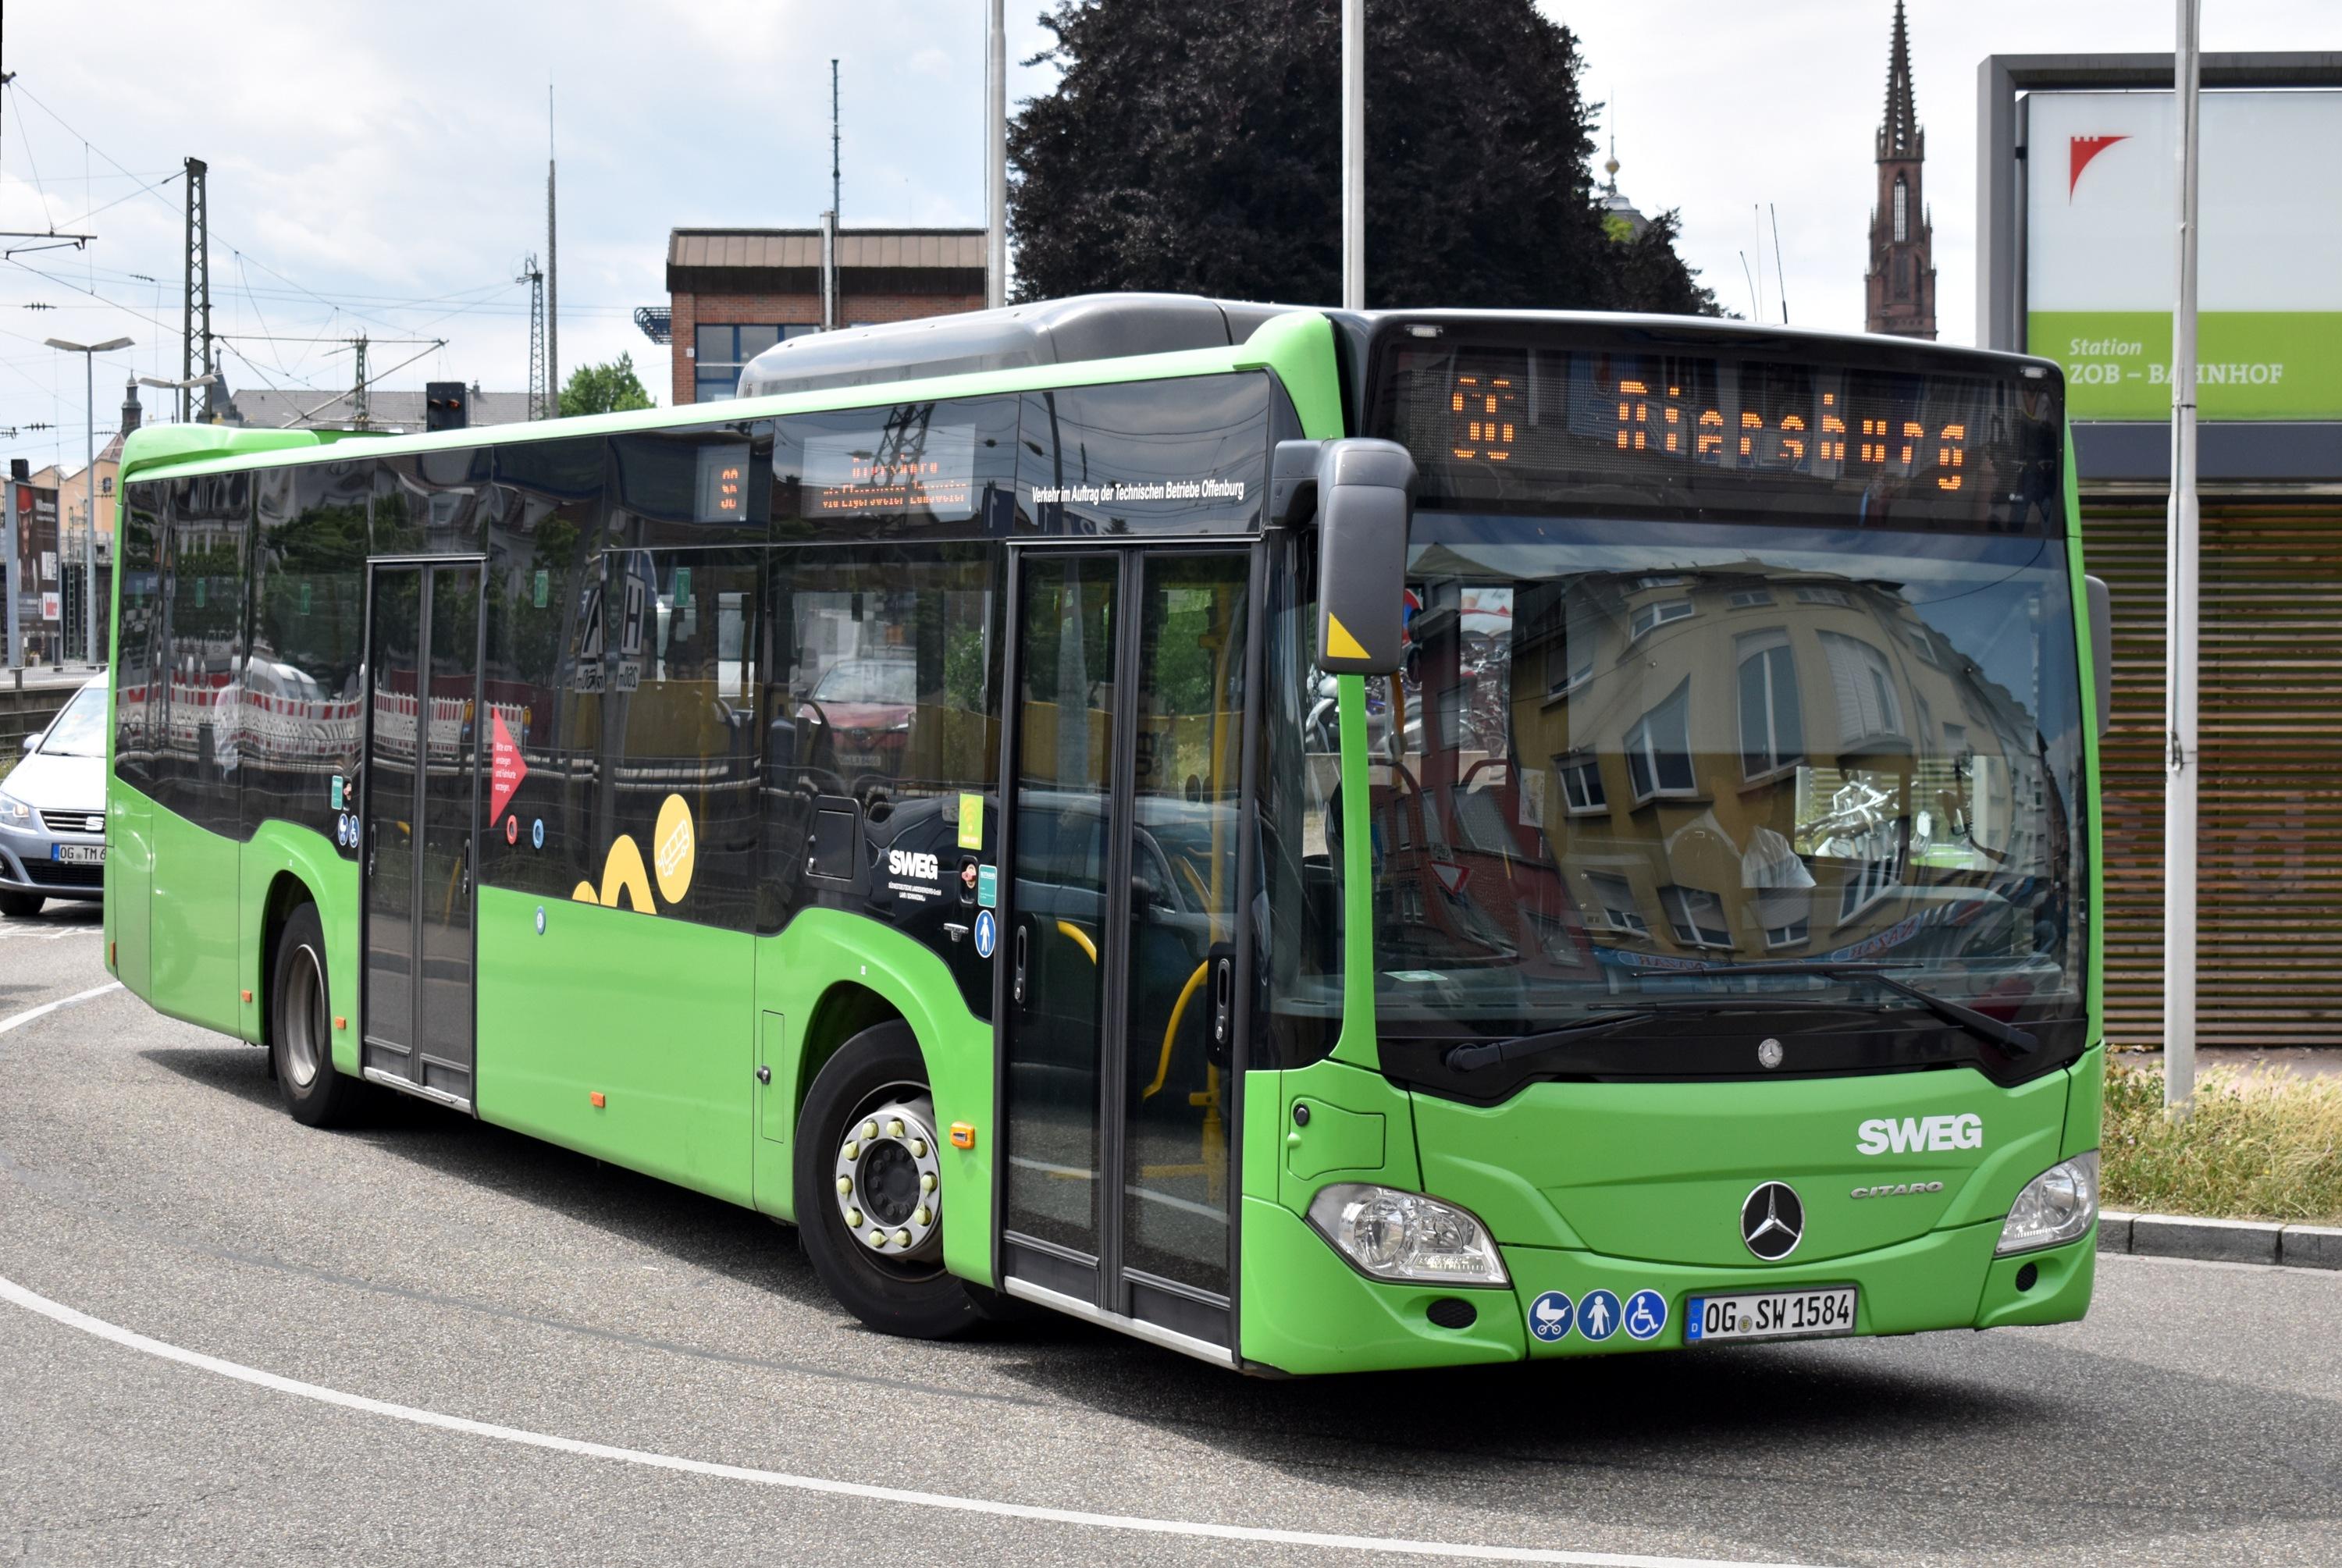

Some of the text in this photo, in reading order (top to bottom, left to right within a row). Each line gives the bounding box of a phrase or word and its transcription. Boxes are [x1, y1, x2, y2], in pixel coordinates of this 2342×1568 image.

[2069, 338, 2142, 356] Station
[2069, 364, 2120, 384] ZOB
[1032, 479, 1244, 506] Verkehr im Auftrag der Technischen Betriebe Offenburg
[60, 847, 74, 859] OG
[84, 847, 97, 859] TM
[888, 850, 938, 880] SWEG
[1856, 1113, 1983, 1155] SWEG
[1850, 1181, 1945, 1200] CITARO
[1691, 1293, 1849, 1333] D OG SW 1584
